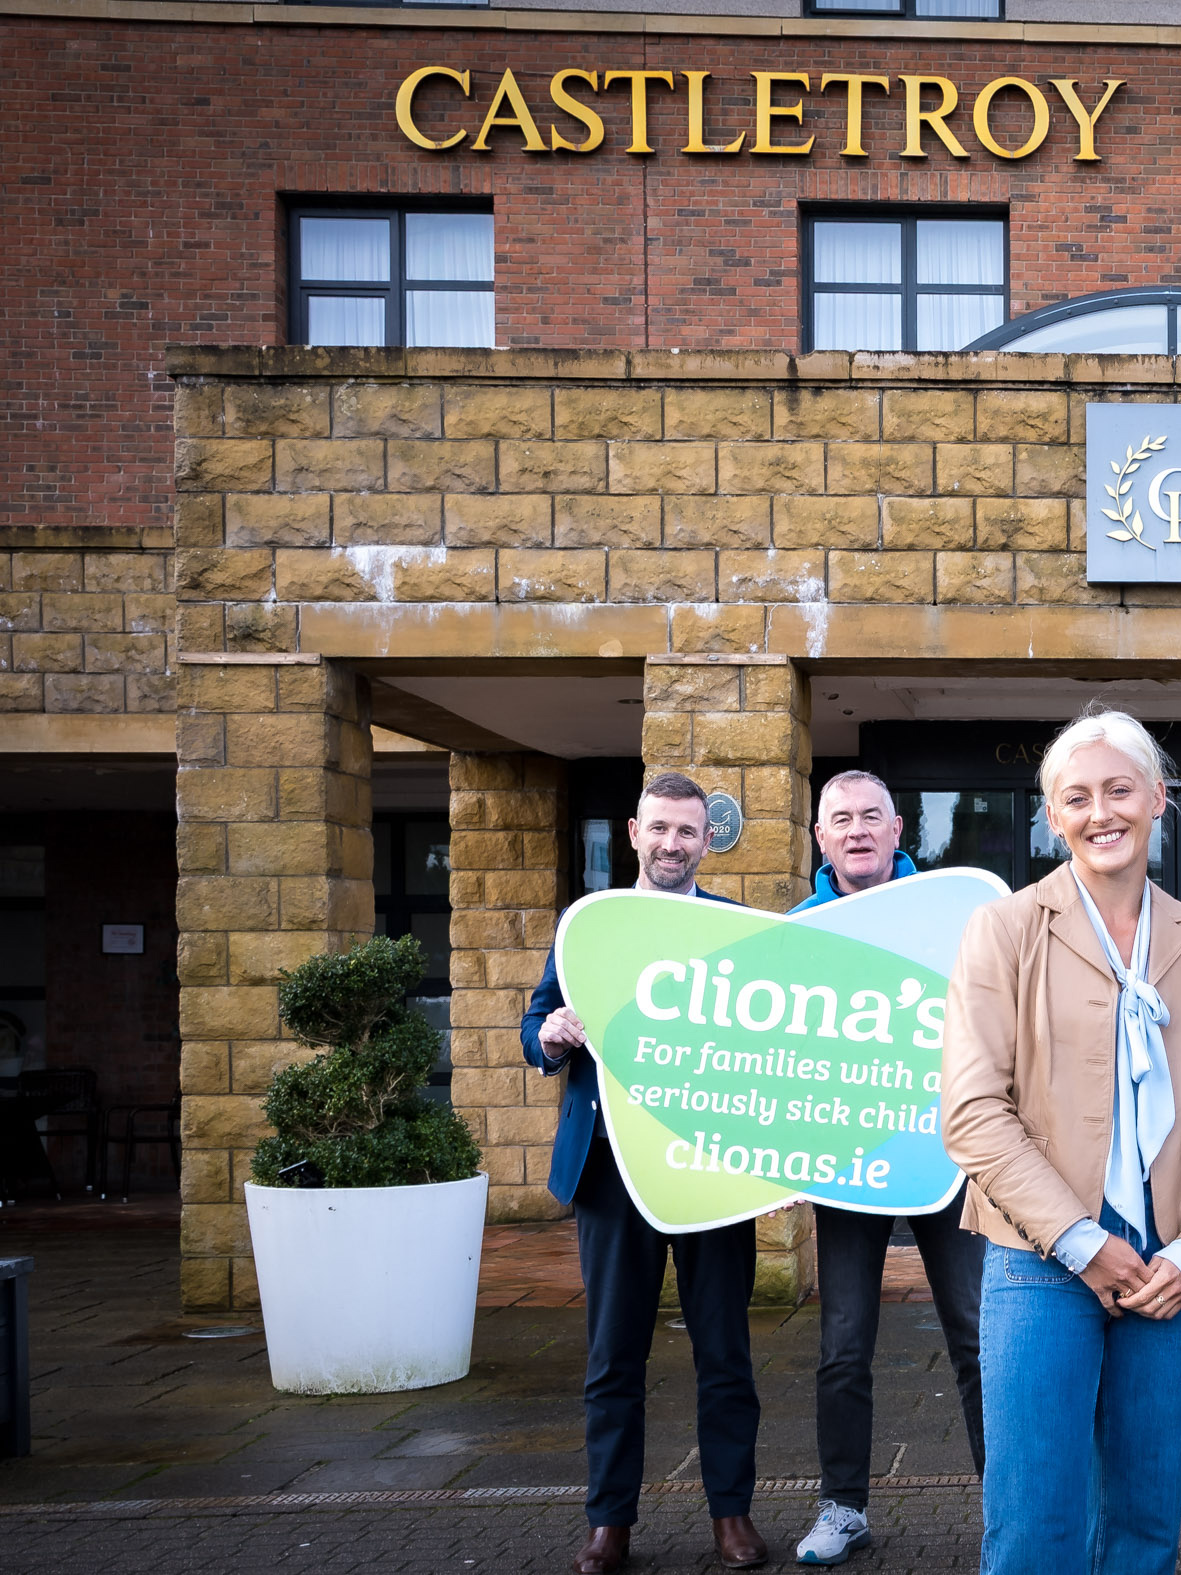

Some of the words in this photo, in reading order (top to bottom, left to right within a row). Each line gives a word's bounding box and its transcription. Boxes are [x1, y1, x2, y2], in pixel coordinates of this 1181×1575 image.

[394, 65, 1128, 163] CASTLETROY
[635, 958, 947, 1050] Cliona's
[634, 1036, 691, 1066] For
[693, 1041, 831, 1082] families
[840, 1058, 914, 1091] with
[922, 1070, 942, 1093] a
[627, 1083, 777, 1126] seriously
[786, 1094, 851, 1126] sick
[859, 1102, 938, 1135] child
[665, 1131, 892, 1190] clionas.ie
